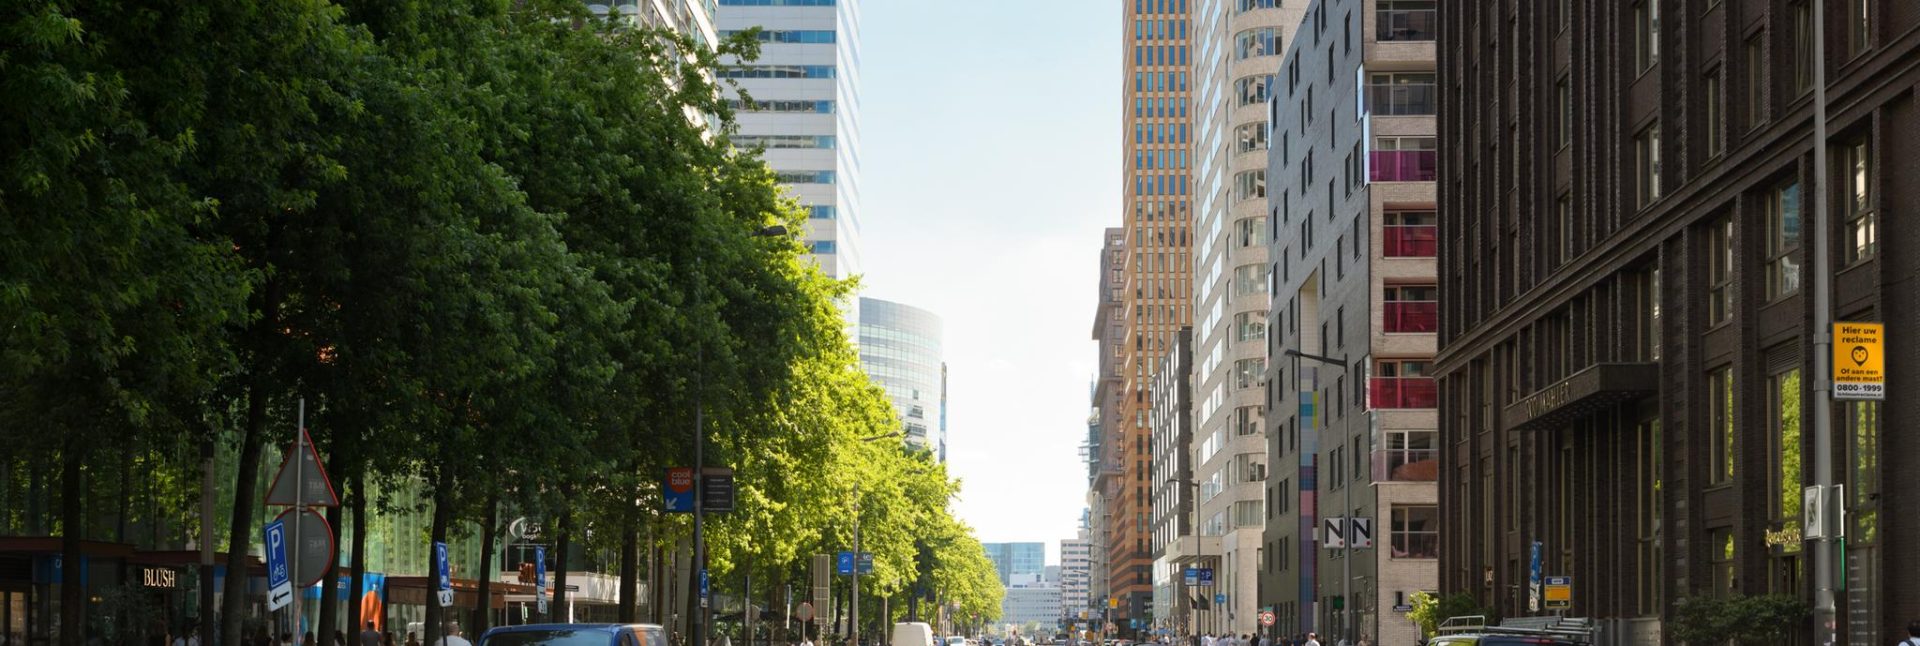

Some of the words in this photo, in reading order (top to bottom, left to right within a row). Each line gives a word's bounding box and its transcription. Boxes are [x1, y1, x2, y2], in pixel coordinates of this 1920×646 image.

[1842, 326, 1861, 334] Hier
[1842, 335, 1877, 343] reclame
[671, 470, 690, 478] cool
[671, 478, 691, 486] blue
[270, 529, 280, 560] P
[144, 568, 175, 588] BLUSH
